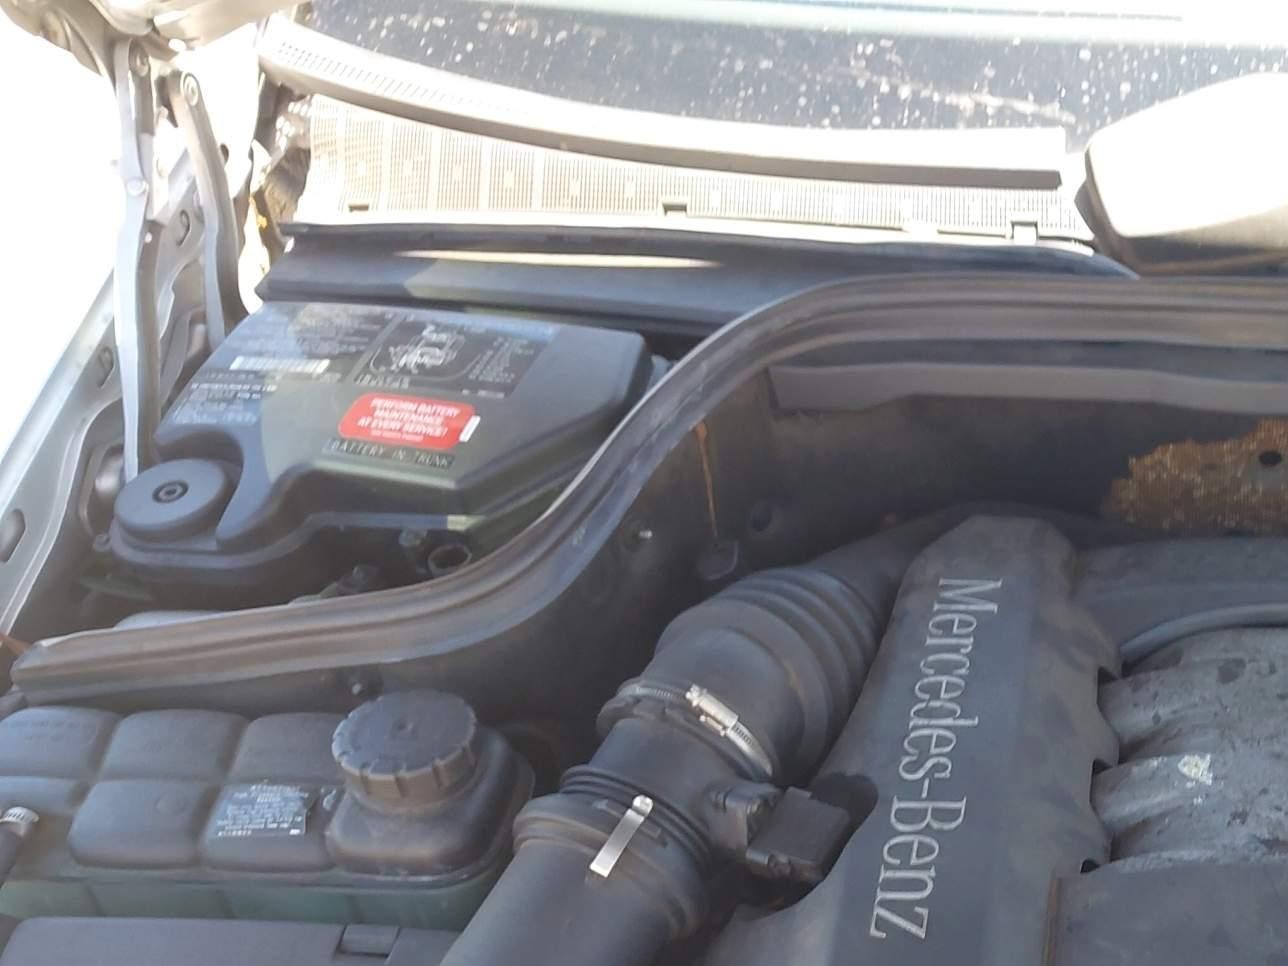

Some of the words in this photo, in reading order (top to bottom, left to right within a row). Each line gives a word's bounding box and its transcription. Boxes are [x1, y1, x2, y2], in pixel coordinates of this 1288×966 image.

[371, 398, 418, 411] PERFORM
[416, 403, 460, 417] BATTERY
[373, 408, 445, 425] MAINTENANCE
[357, 416, 373, 428] AT
[370, 418, 402, 432] EVERY
[331, 439, 384, 457] BATTERY
[392, 448, 406, 460] IN
[415, 451, 450, 468] TRUNK
[870, 577, 1002, 940] Mercedes-Benz
